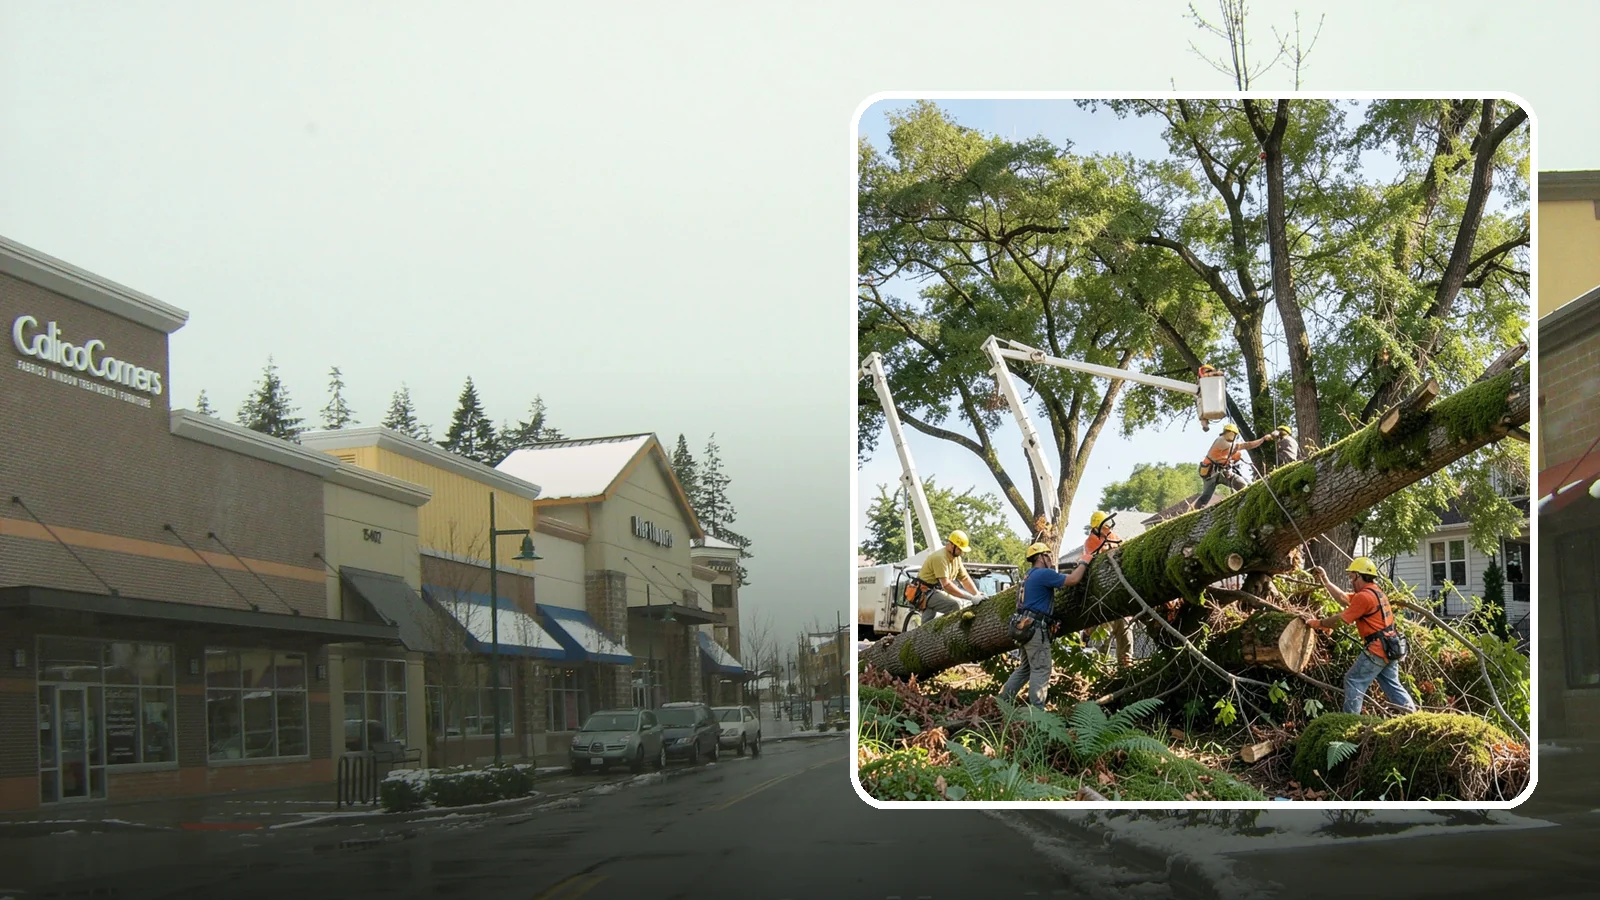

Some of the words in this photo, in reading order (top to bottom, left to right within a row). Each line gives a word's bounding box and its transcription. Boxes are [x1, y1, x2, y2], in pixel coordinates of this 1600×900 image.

[17, 360, 47, 378] FABRICS
[51, 370, 78, 387] WINDOW
[79, 378, 117, 398] TREATMENTS
